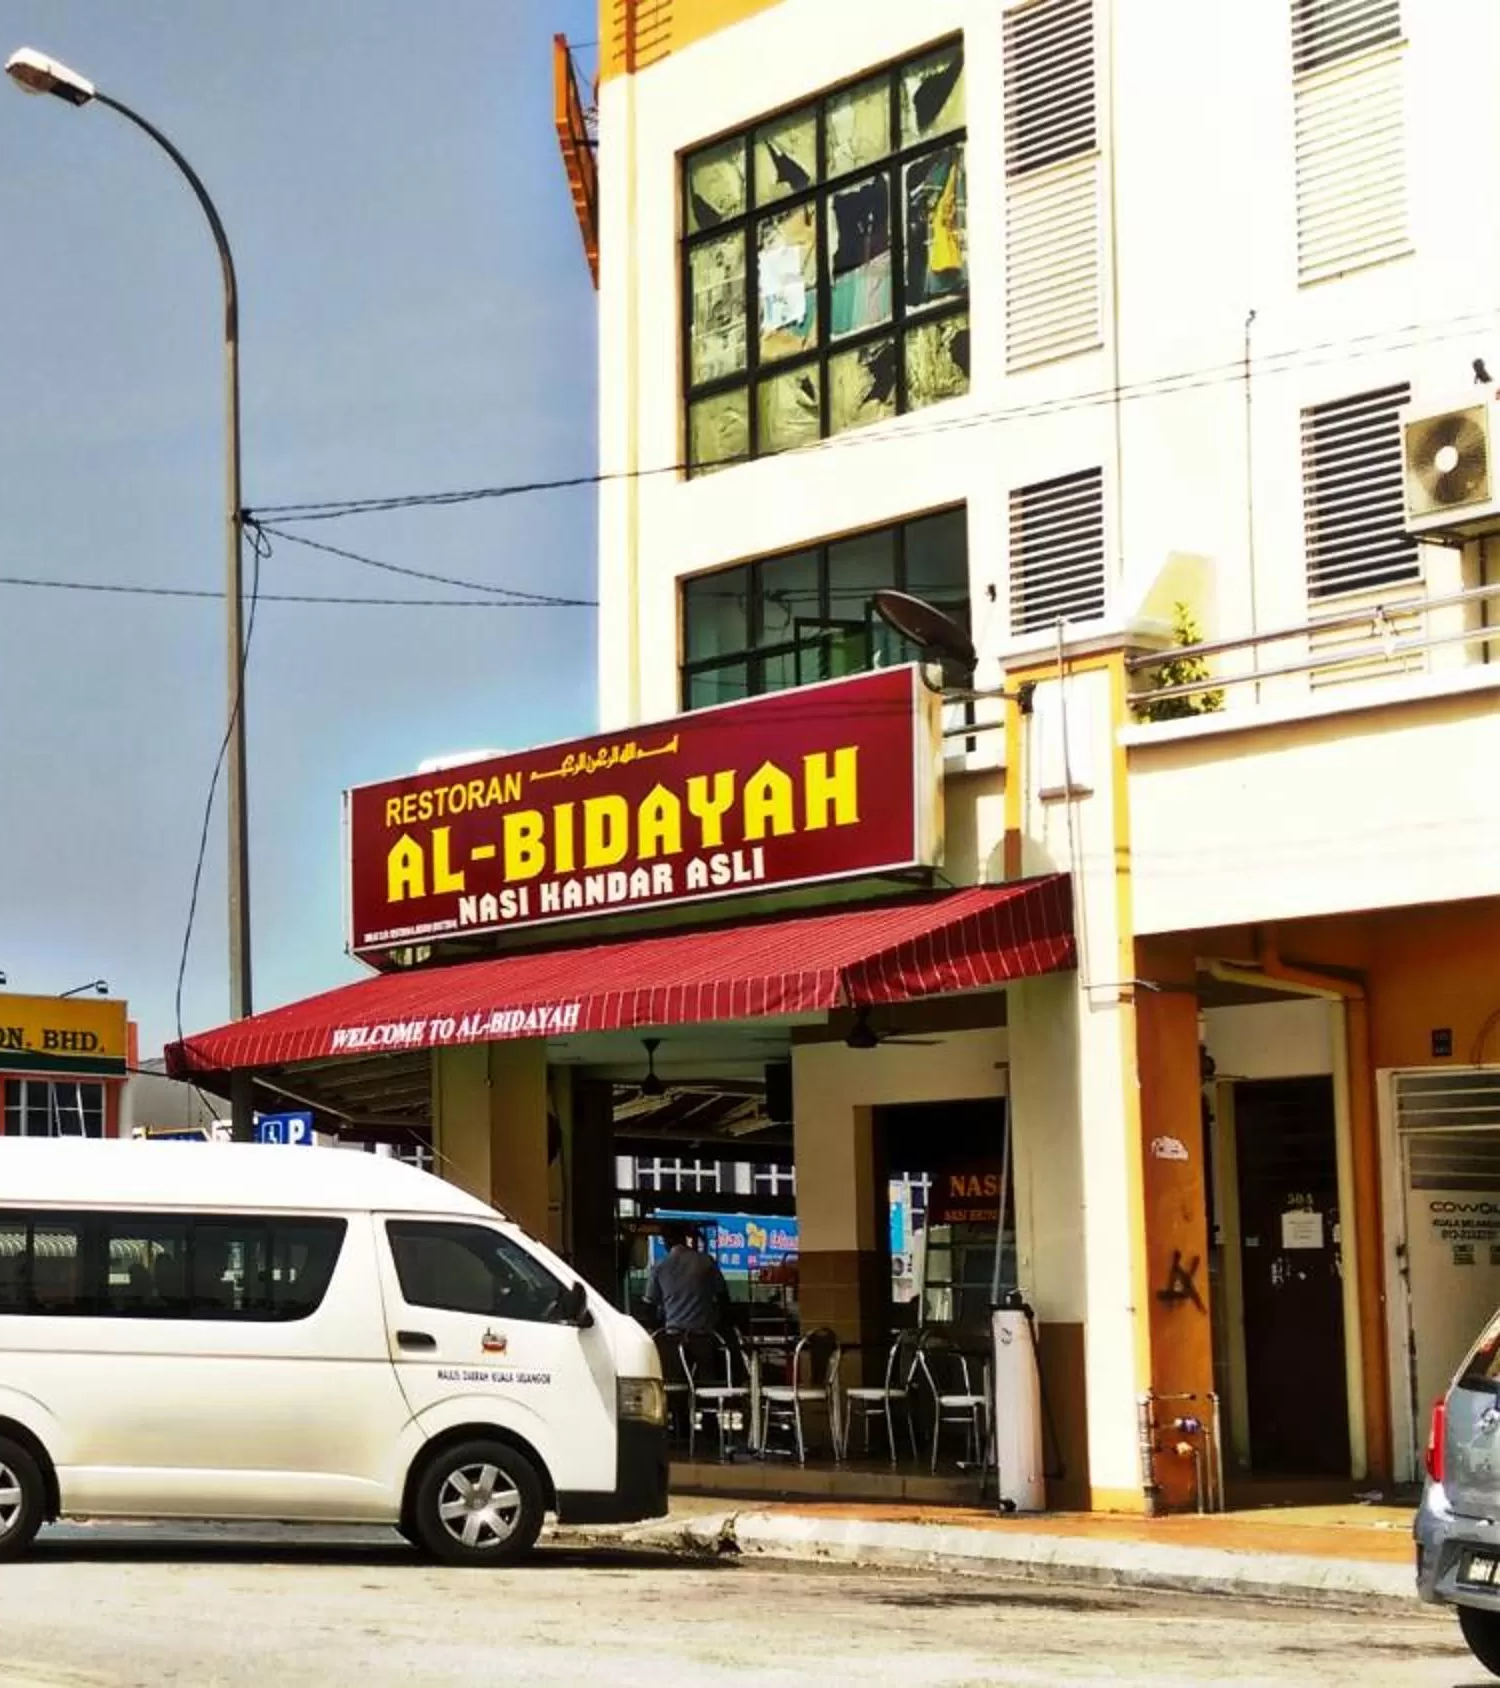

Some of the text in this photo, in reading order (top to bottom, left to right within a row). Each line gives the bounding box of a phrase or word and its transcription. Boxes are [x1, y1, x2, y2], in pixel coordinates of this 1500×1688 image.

[385, 771, 523, 828] RESTORAN
[386, 745, 861, 903] AL-BIDAYAH
[458, 847, 765, 926] NASI KANDAR ASLI
[41, 1028, 106, 1053] BHD.
[330, 1003, 582, 1051] WELCOME TO AL-BIDAYAH
[288, 1118, 306, 1145] P
